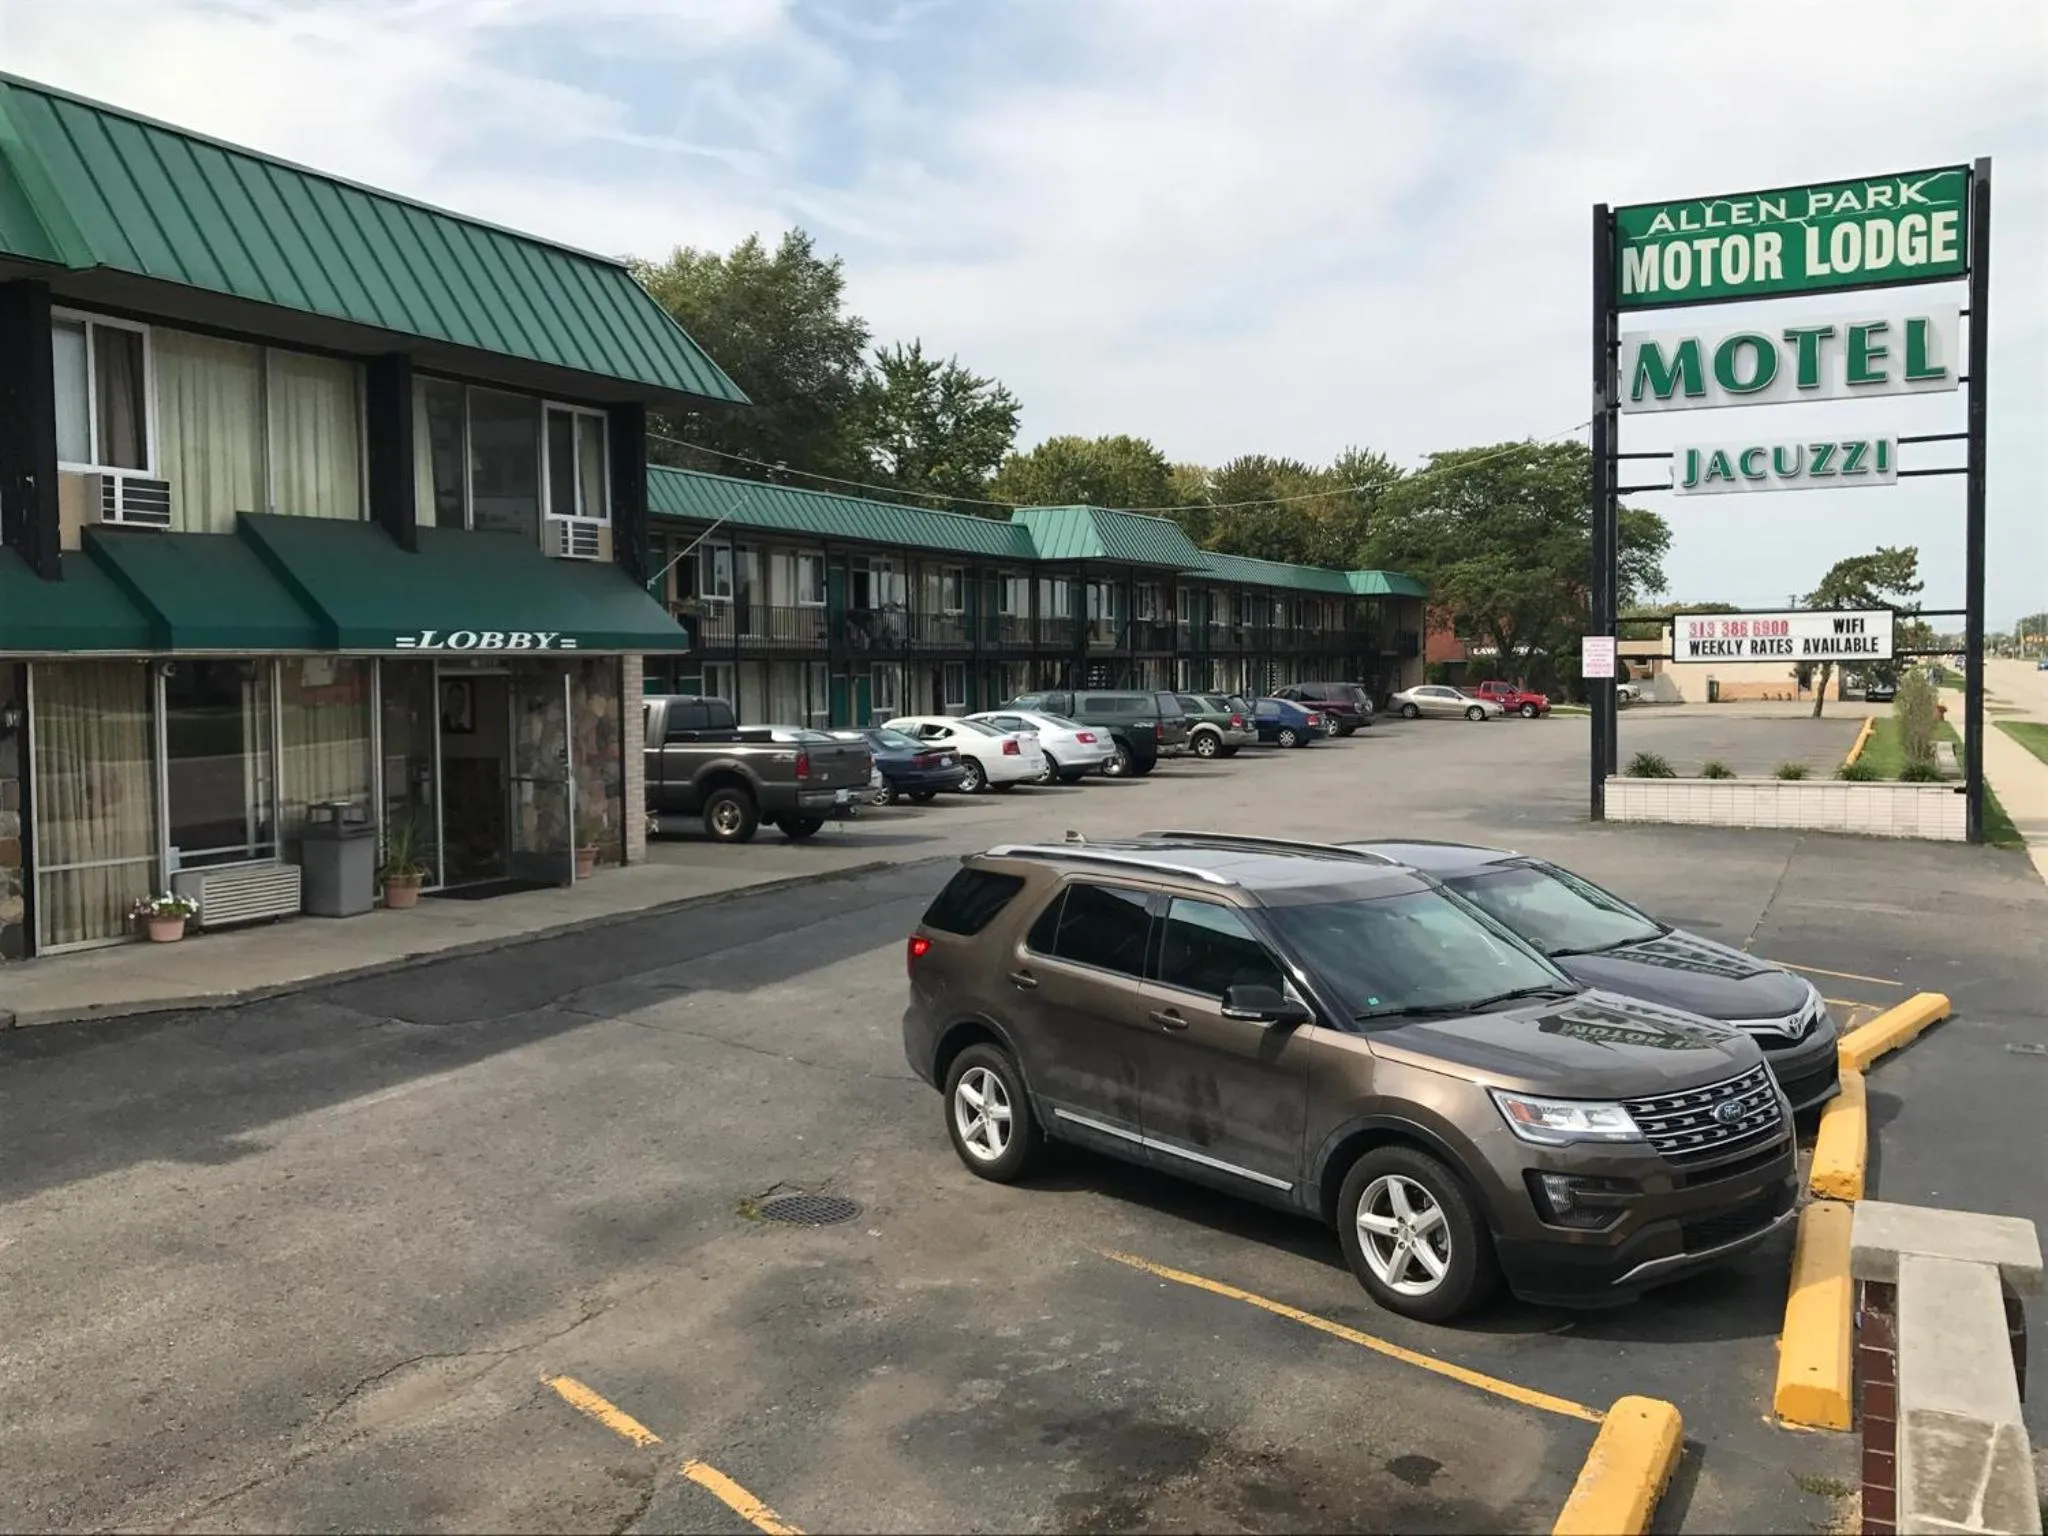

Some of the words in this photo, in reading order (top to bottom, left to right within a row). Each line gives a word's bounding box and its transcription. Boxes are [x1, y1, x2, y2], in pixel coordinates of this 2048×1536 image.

[1648, 196, 1788, 236] ALLEN
[1807, 177, 1931, 218] PARK
[1622, 231, 1783, 294] MOTOR
[1805, 210, 1959, 276] LODGE
[1631, 317, 1947, 401] MOTEL
[1683, 439, 1890, 487] JACUZZI
[1689, 621, 1715, 637] 313
[1721, 621, 1748, 637] 386
[1753, 620, 1789, 636] 6900
[1833, 618, 1865, 634] WIFI
[416, 630, 559, 650] LOBBY
[1689, 640, 1743, 656] WEEKLY
[1750, 639, 1793, 655] RATES
[1803, 637, 1879, 654] AVAILABLE
[1473, 647, 1496, 655] LAW
